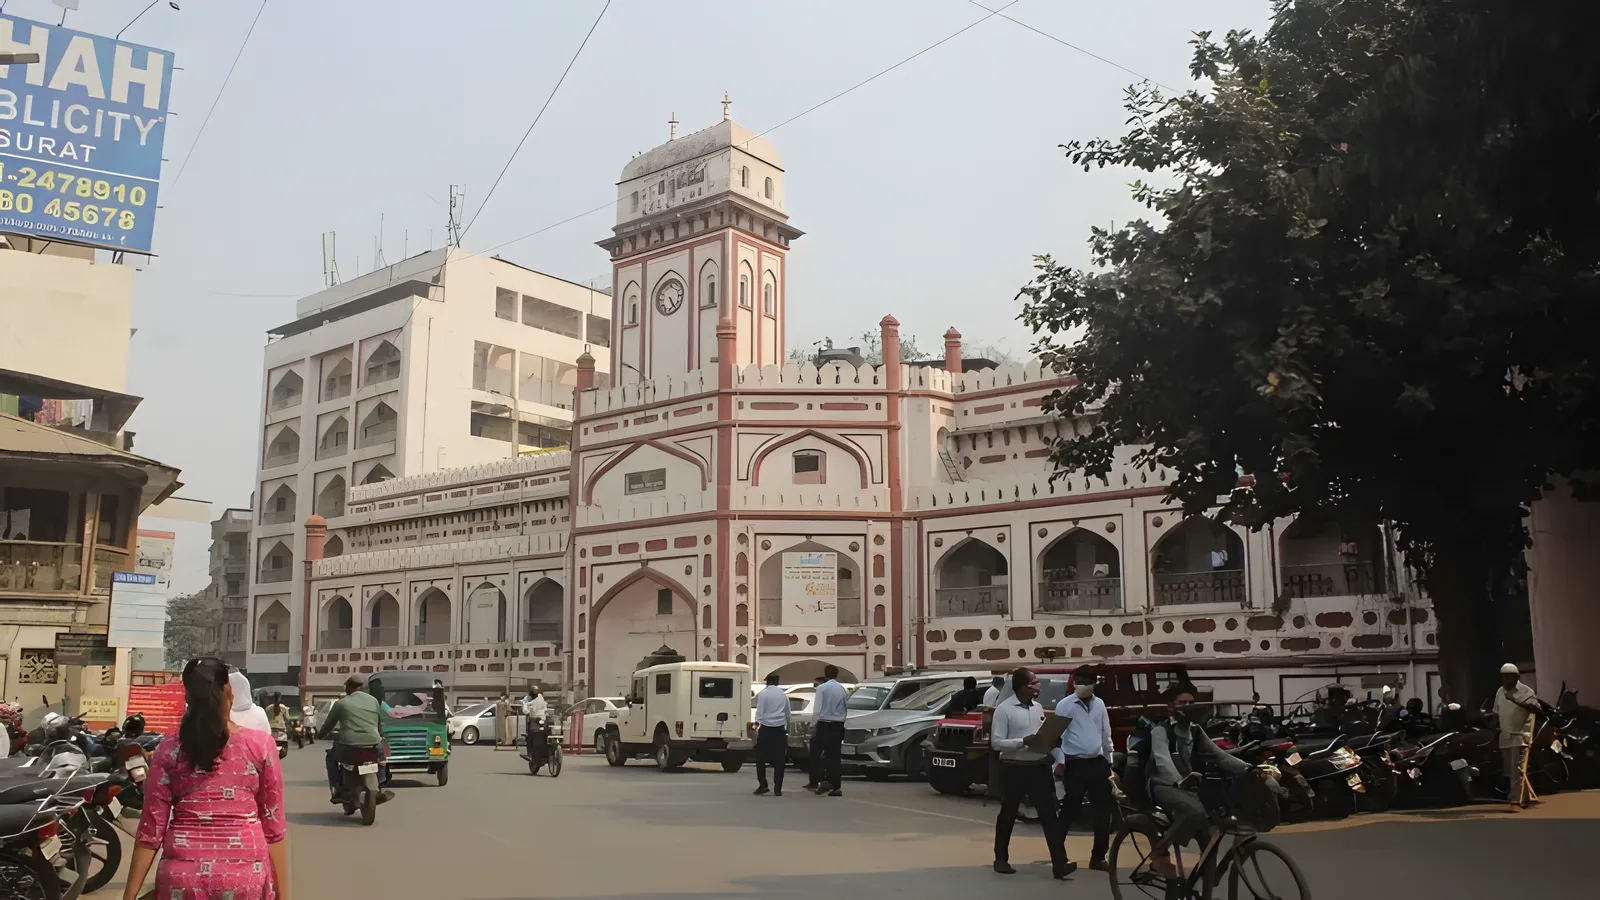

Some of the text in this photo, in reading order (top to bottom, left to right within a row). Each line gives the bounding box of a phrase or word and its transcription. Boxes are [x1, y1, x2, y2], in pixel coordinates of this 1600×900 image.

[0, 18, 165, 110] HAH
[0, 88, 160, 146] BLICITY
[0, 129, 97, 163] SURAT
[44, 198, 136, 230] 45678
